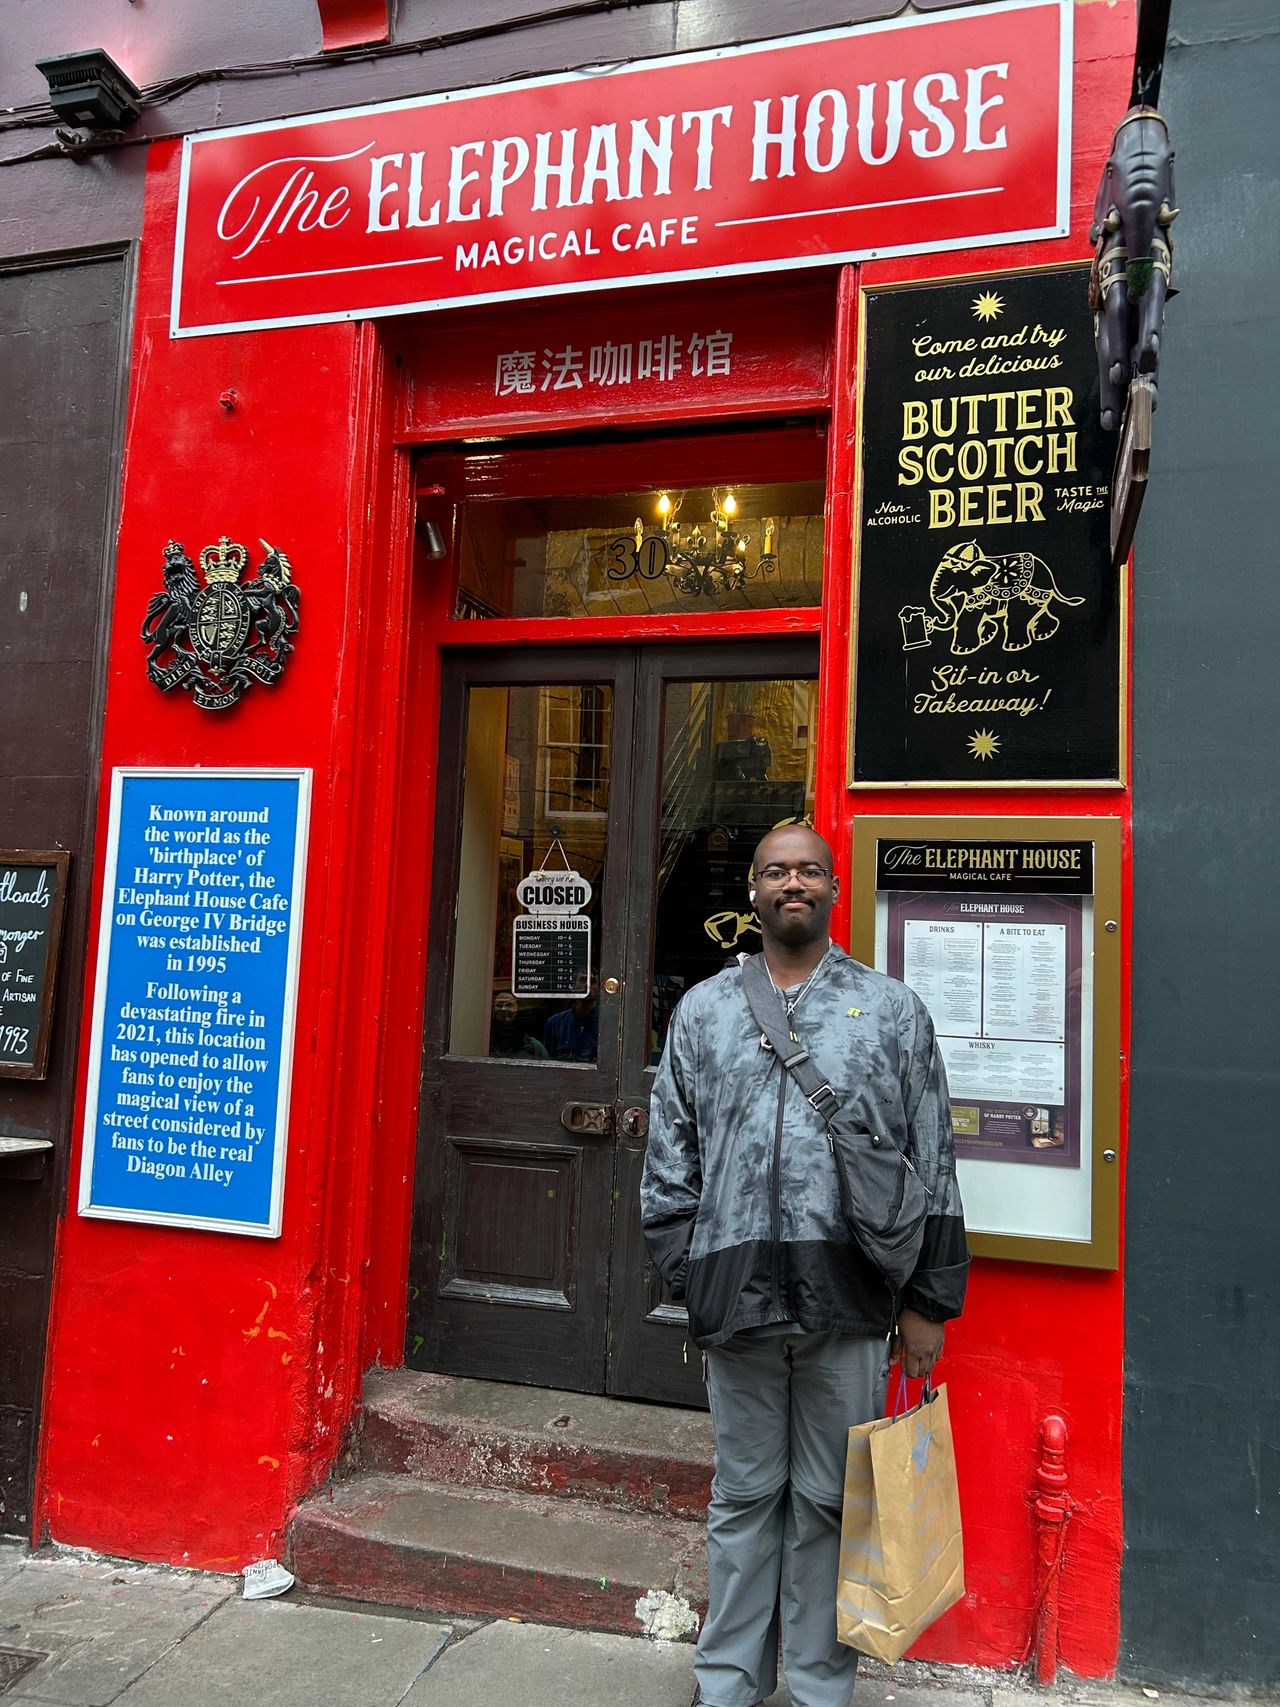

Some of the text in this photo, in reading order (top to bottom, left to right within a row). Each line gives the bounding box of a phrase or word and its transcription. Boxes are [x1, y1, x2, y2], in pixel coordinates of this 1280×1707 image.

[216, 61, 1010, 259] The ELEPHANT HOUSE
[454, 214, 700, 272] MAGICAL CAFE
[912, 323, 1067, 357] Come and try
[494, 329, 734, 397] 魔法咖啡馆
[914, 352, 1063, 383] our delicious
[902, 386, 1076, 441] BUTTER
[898, 431, 1078, 486] SCOTCH
[928, 481, 1046, 529] BEER
[1055, 486, 1108, 498] TASTE THE
[874, 501, 911, 515] Non-
[1056, 498, 1104, 513] Magic
[867, 514, 921, 526] ALCOHOLIC
[607, 536, 668, 580] 30
[165, 659, 276, 706] DIEU ET MON DROIT
[931, 664, 1040, 692] Sit-in or
[913, 689, 1052, 717] Takeaway!
[149, 804, 269, 823] Known around
[144, 826, 271, 845] the world as the
[149, 847, 266, 868] 'birthplace' of
[884, 844, 1081, 870] The ELEPHANT HOUSE
[134, 867, 276, 890] Harry Potter, the
[950, 872, 1012, 881] MAGICAL CAFE
[118, 888, 288, 910] Elephant House Cafe
[523, 885, 586, 906] CLOSED
[960, 903, 999, 914] ELEPHANT
[1000, 904, 1025, 914] HOUSE
[116, 910, 287, 936] on George IV Bridge
[516, 920, 589, 930] BUSINESS HOURS
[929, 925, 955, 934] DRINKS
[1006, 928, 1022, 936] BITE
[137, 934, 261, 953] was established
[1, 971, 12, 982] OF
[166, 954, 227, 973] in 1995
[2, 988, 37, 1003] ARTISAN
[146, 981, 241, 1006] Following a
[120, 1002, 265, 1028] devastating fire in
[116, 1023, 266, 1050] 2021, this location
[968, 1041, 996, 1049] WHISKY
[110, 1044, 269, 1072] has opened to allow
[121, 1067, 253, 1096] fans to enjoy the
[117, 1091, 254, 1117] magical view of a
[103, 1111, 266, 1144] street considered by
[111, 1132, 253, 1162] fans to be the real
[126, 1155, 234, 1187] Diagon Alley
